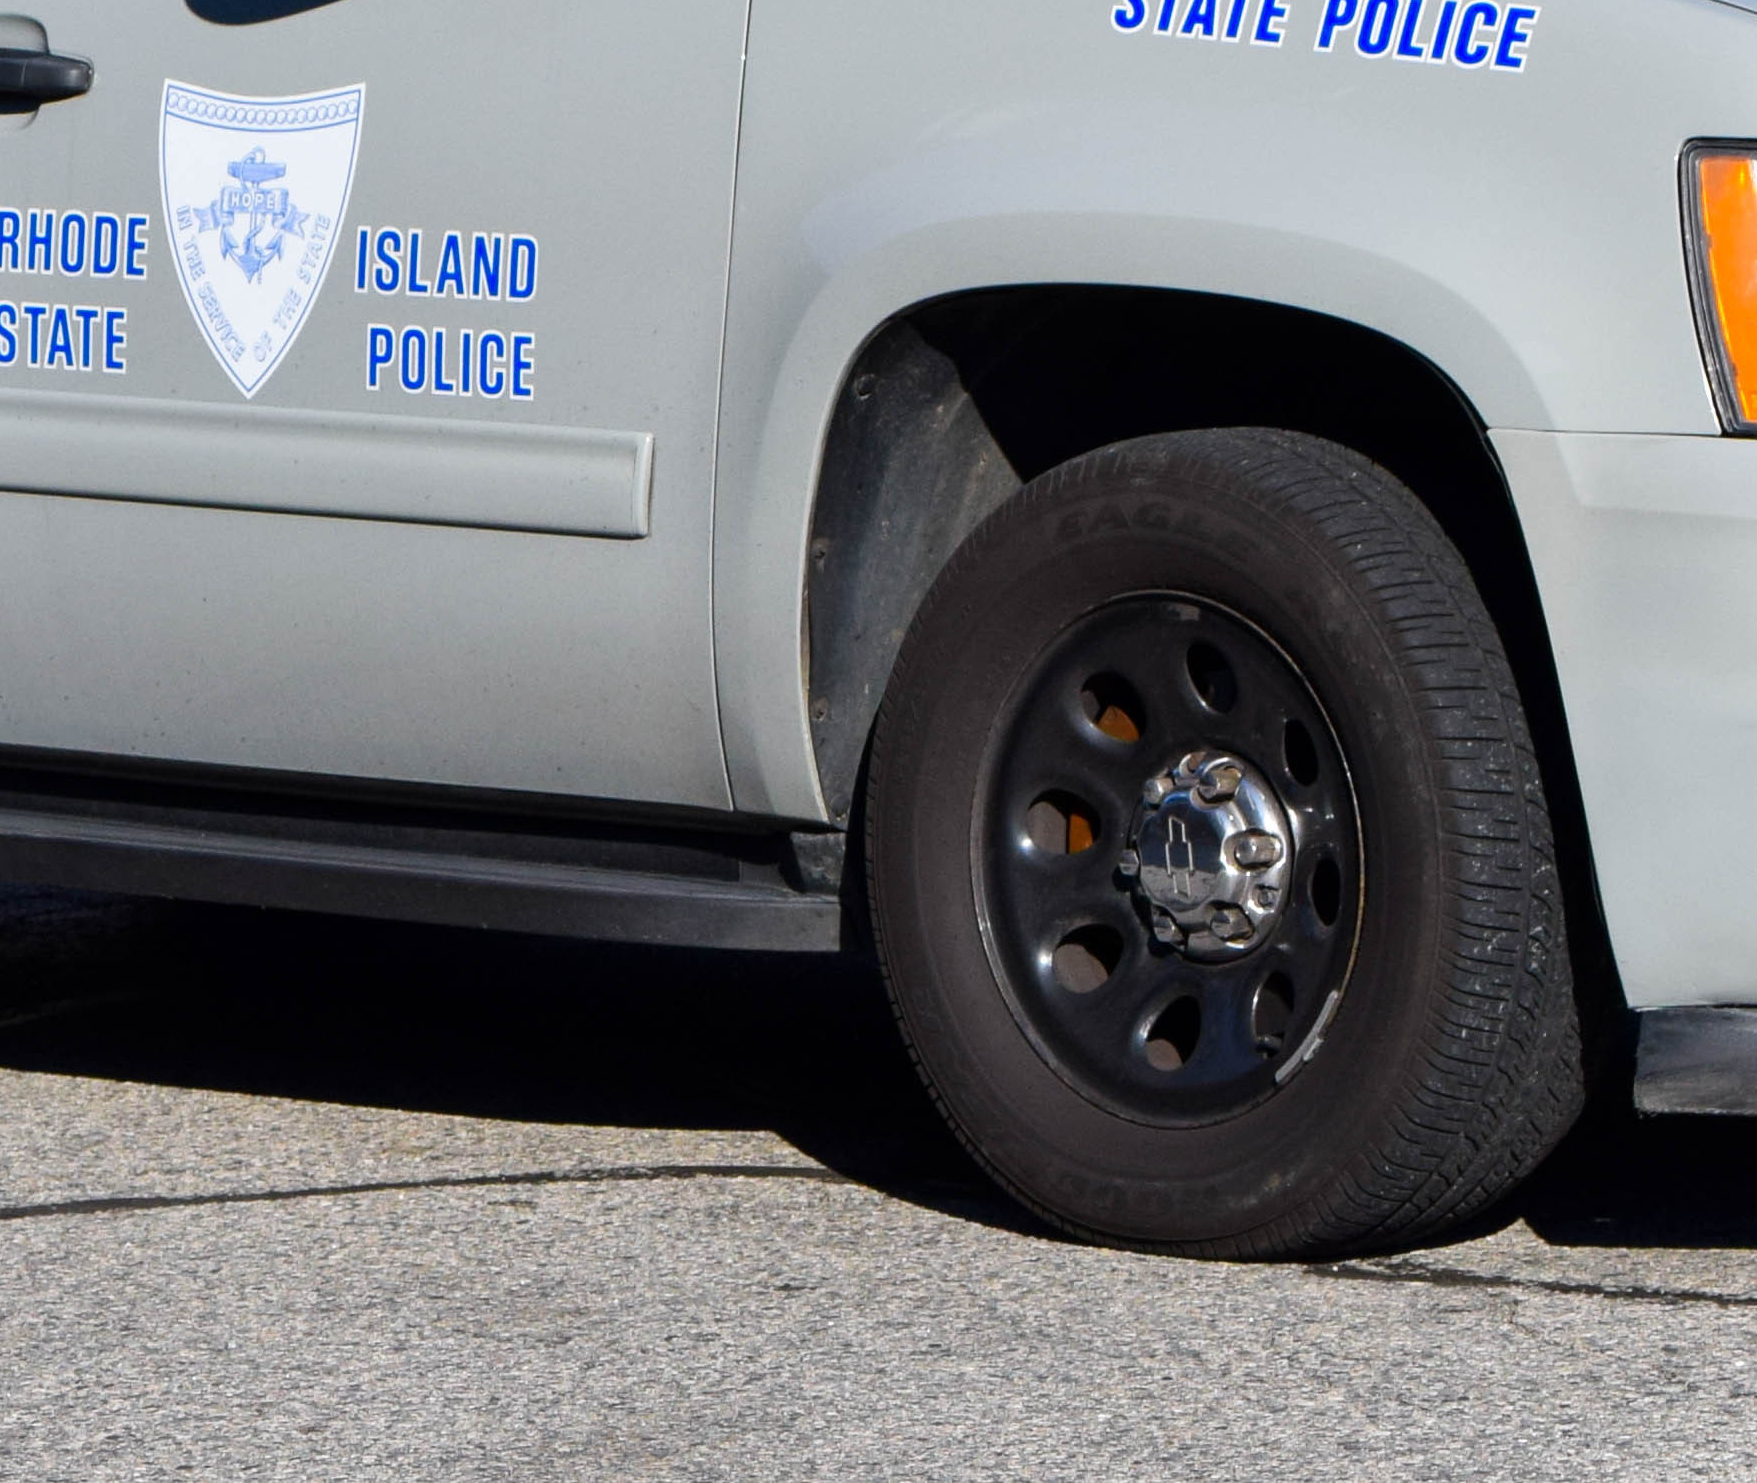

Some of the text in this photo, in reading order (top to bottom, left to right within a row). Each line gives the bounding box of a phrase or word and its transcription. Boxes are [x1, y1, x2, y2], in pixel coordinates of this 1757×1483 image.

[231, 193, 274, 210] HOPE
[354, 225, 537, 302] ISLAND
[365, 324, 536, 400] POLICE
